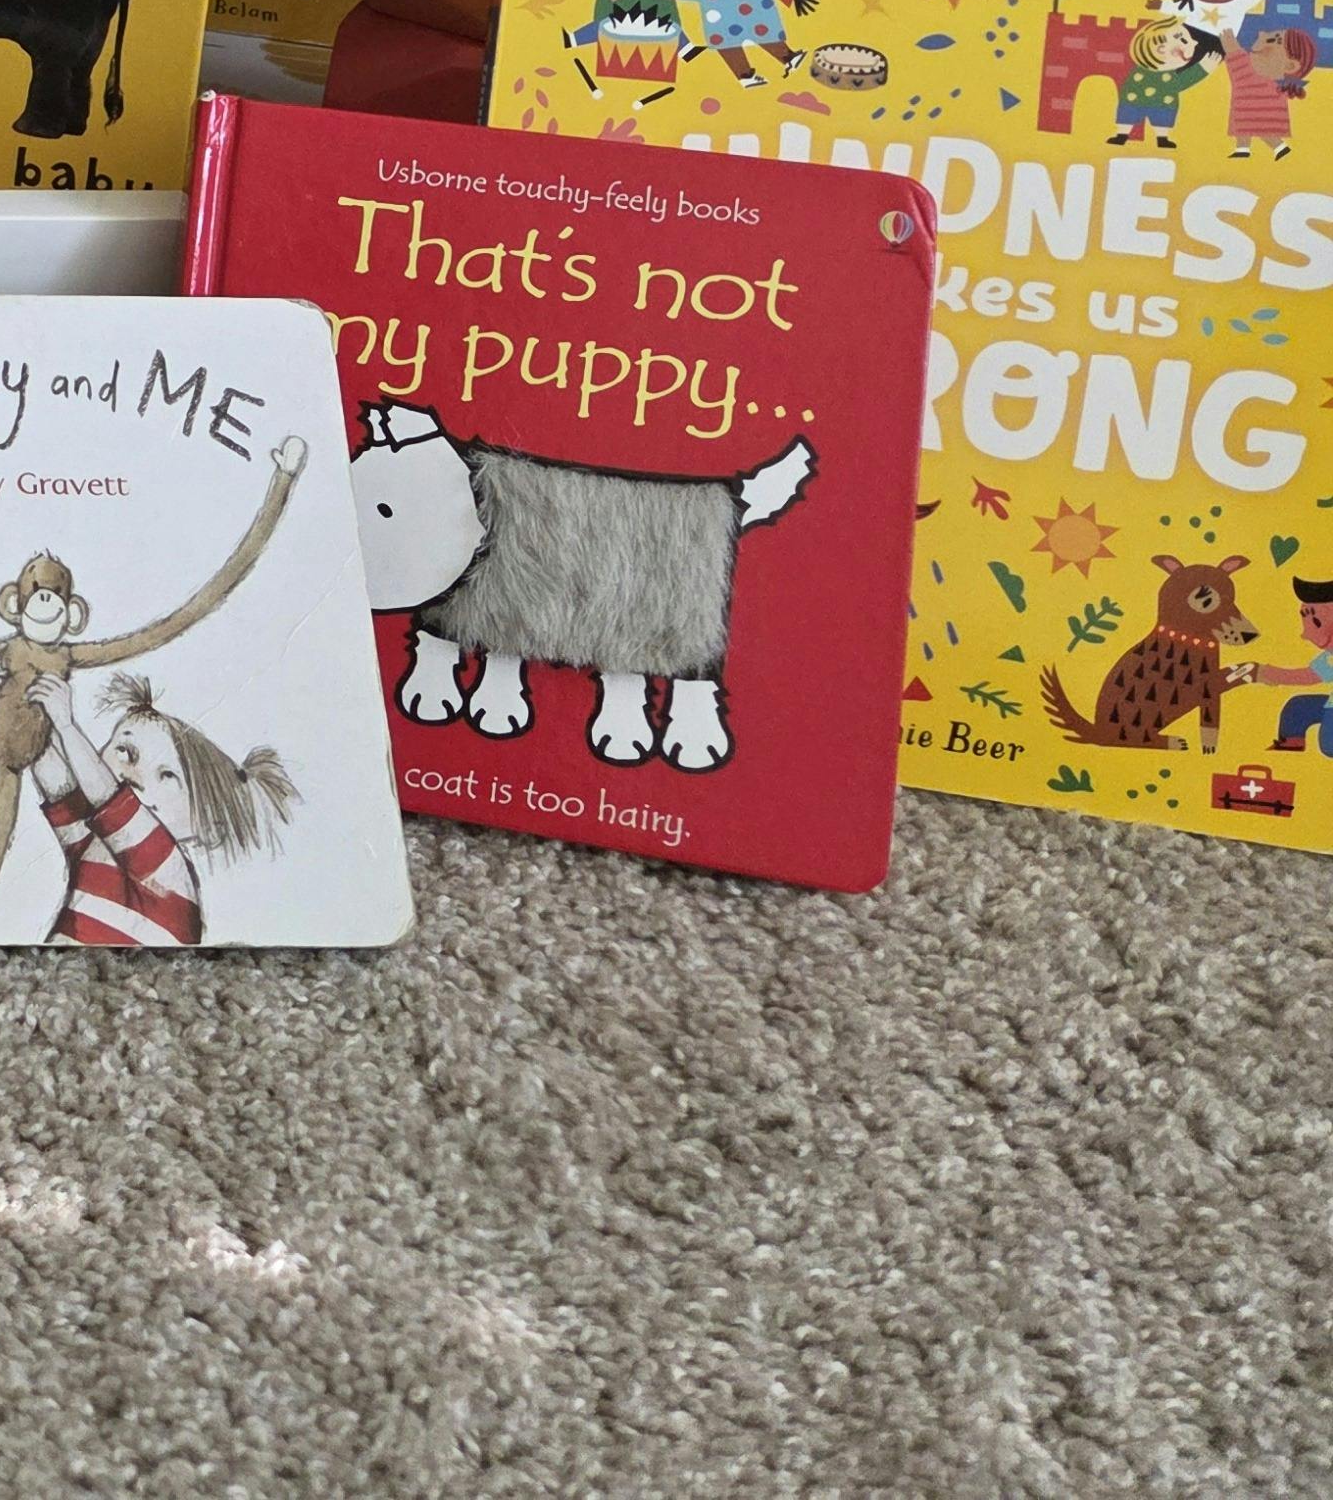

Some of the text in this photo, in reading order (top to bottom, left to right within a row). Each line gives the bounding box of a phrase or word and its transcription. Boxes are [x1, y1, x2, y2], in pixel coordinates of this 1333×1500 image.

[378, 159, 761, 228] Usborne touchy-feely books
[681, 121, 1333, 292] DNESS
[337, 197, 800, 331] That's not
[932, 252, 1180, 338] kes us
[50, 359, 120, 413] and
[136, 349, 266, 461] ME
[324, 311, 816, 440] my puppy...
[921, 329, 1308, 493] RONG
[17, 471, 130, 500] Gravett
[942, 720, 1025, 762] Beer
[403, 763, 692, 849] coat is too hairy.
